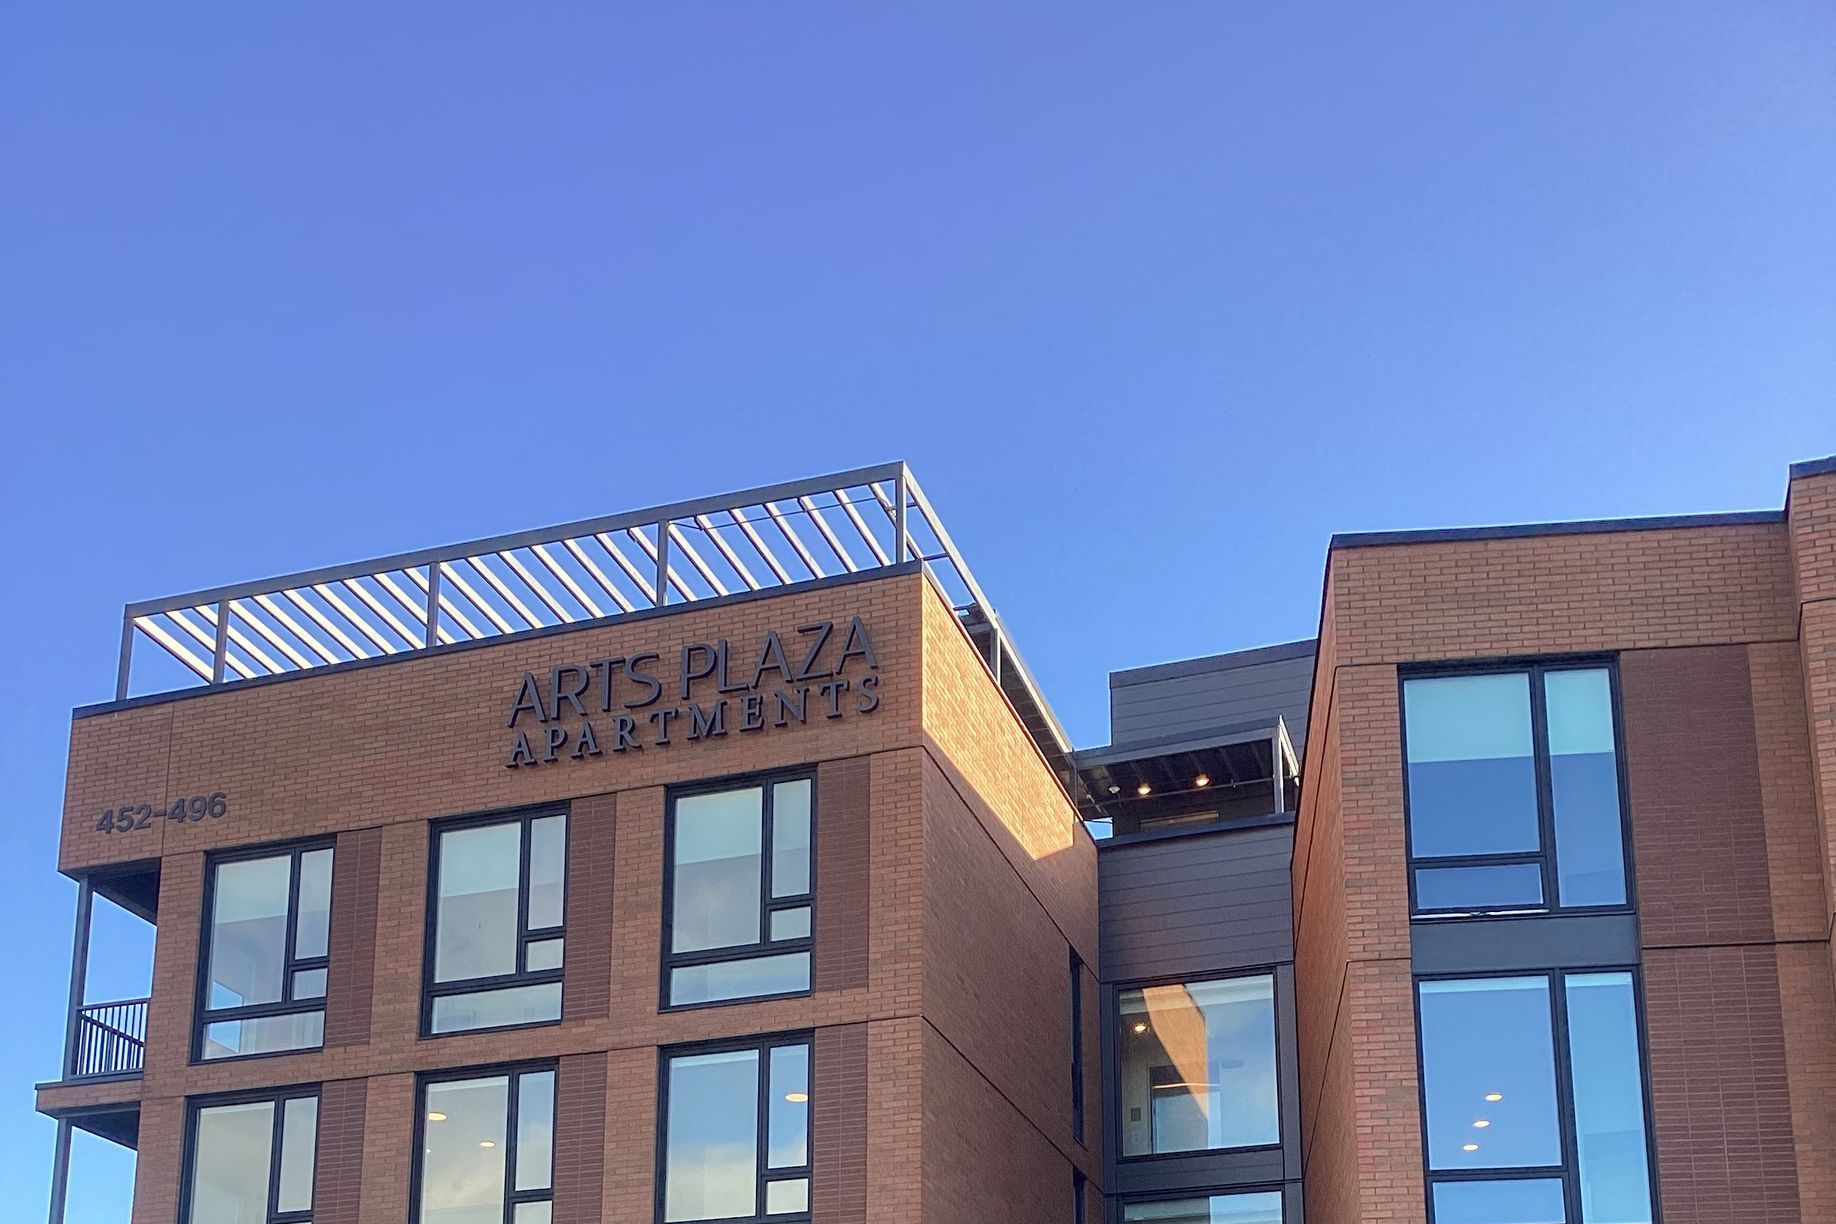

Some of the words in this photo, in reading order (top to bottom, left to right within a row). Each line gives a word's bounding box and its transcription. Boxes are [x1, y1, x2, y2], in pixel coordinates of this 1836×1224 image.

[507, 652, 662, 728] ARTS
[680, 616, 879, 700] PLAZA
[505, 674, 879, 768] APARTMENTS
[95, 791, 227, 835] 452-496
